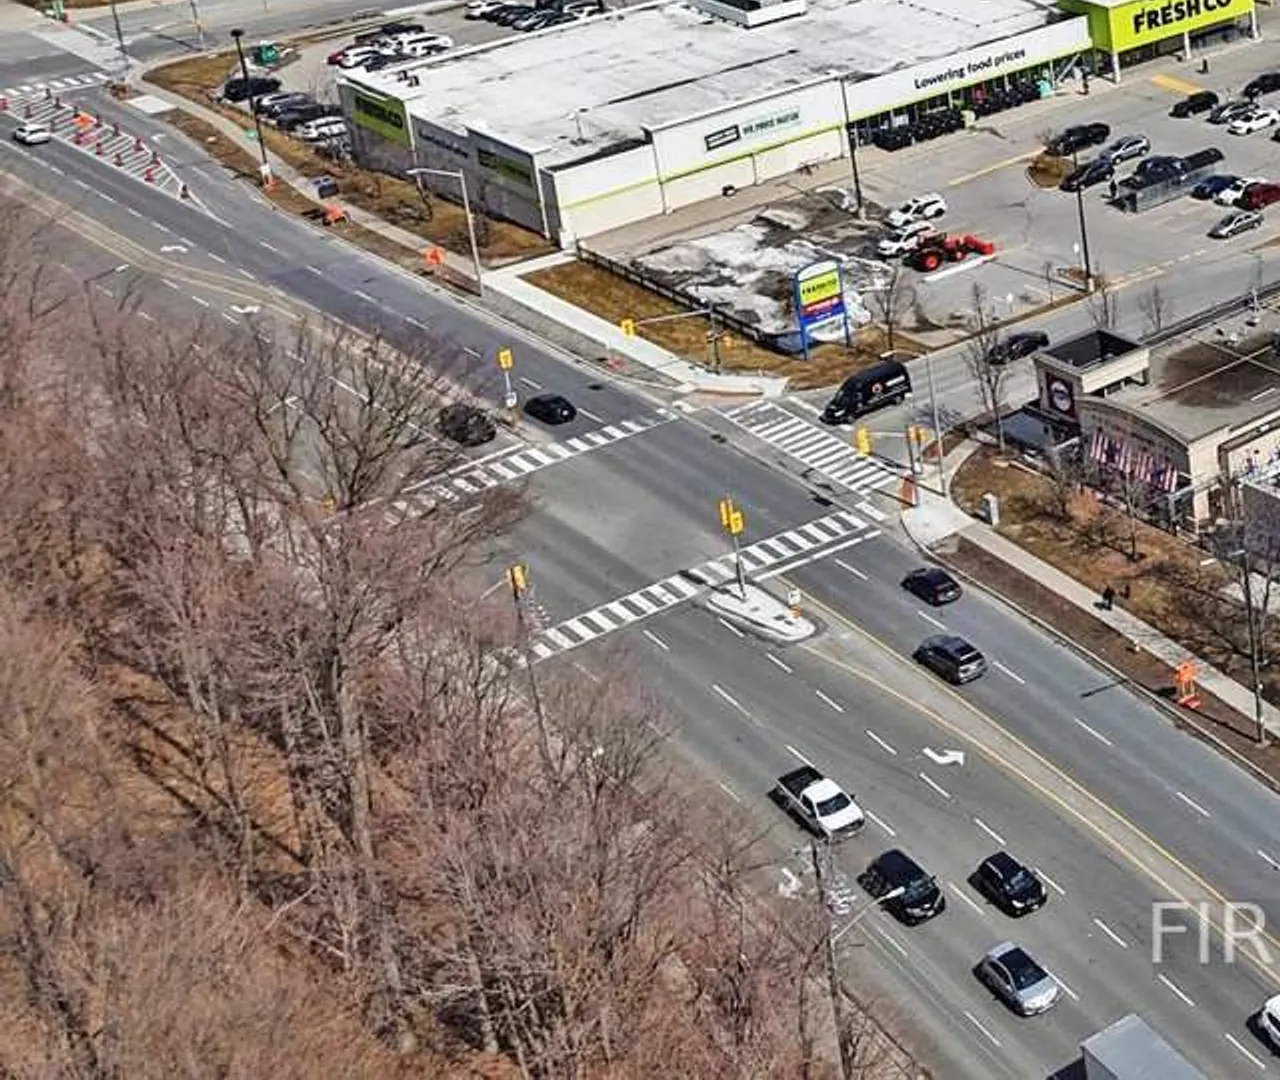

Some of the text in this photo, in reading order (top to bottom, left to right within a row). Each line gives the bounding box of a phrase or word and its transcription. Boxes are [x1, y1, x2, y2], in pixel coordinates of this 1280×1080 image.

[914, 47, 1026, 89] Lowering food prices
